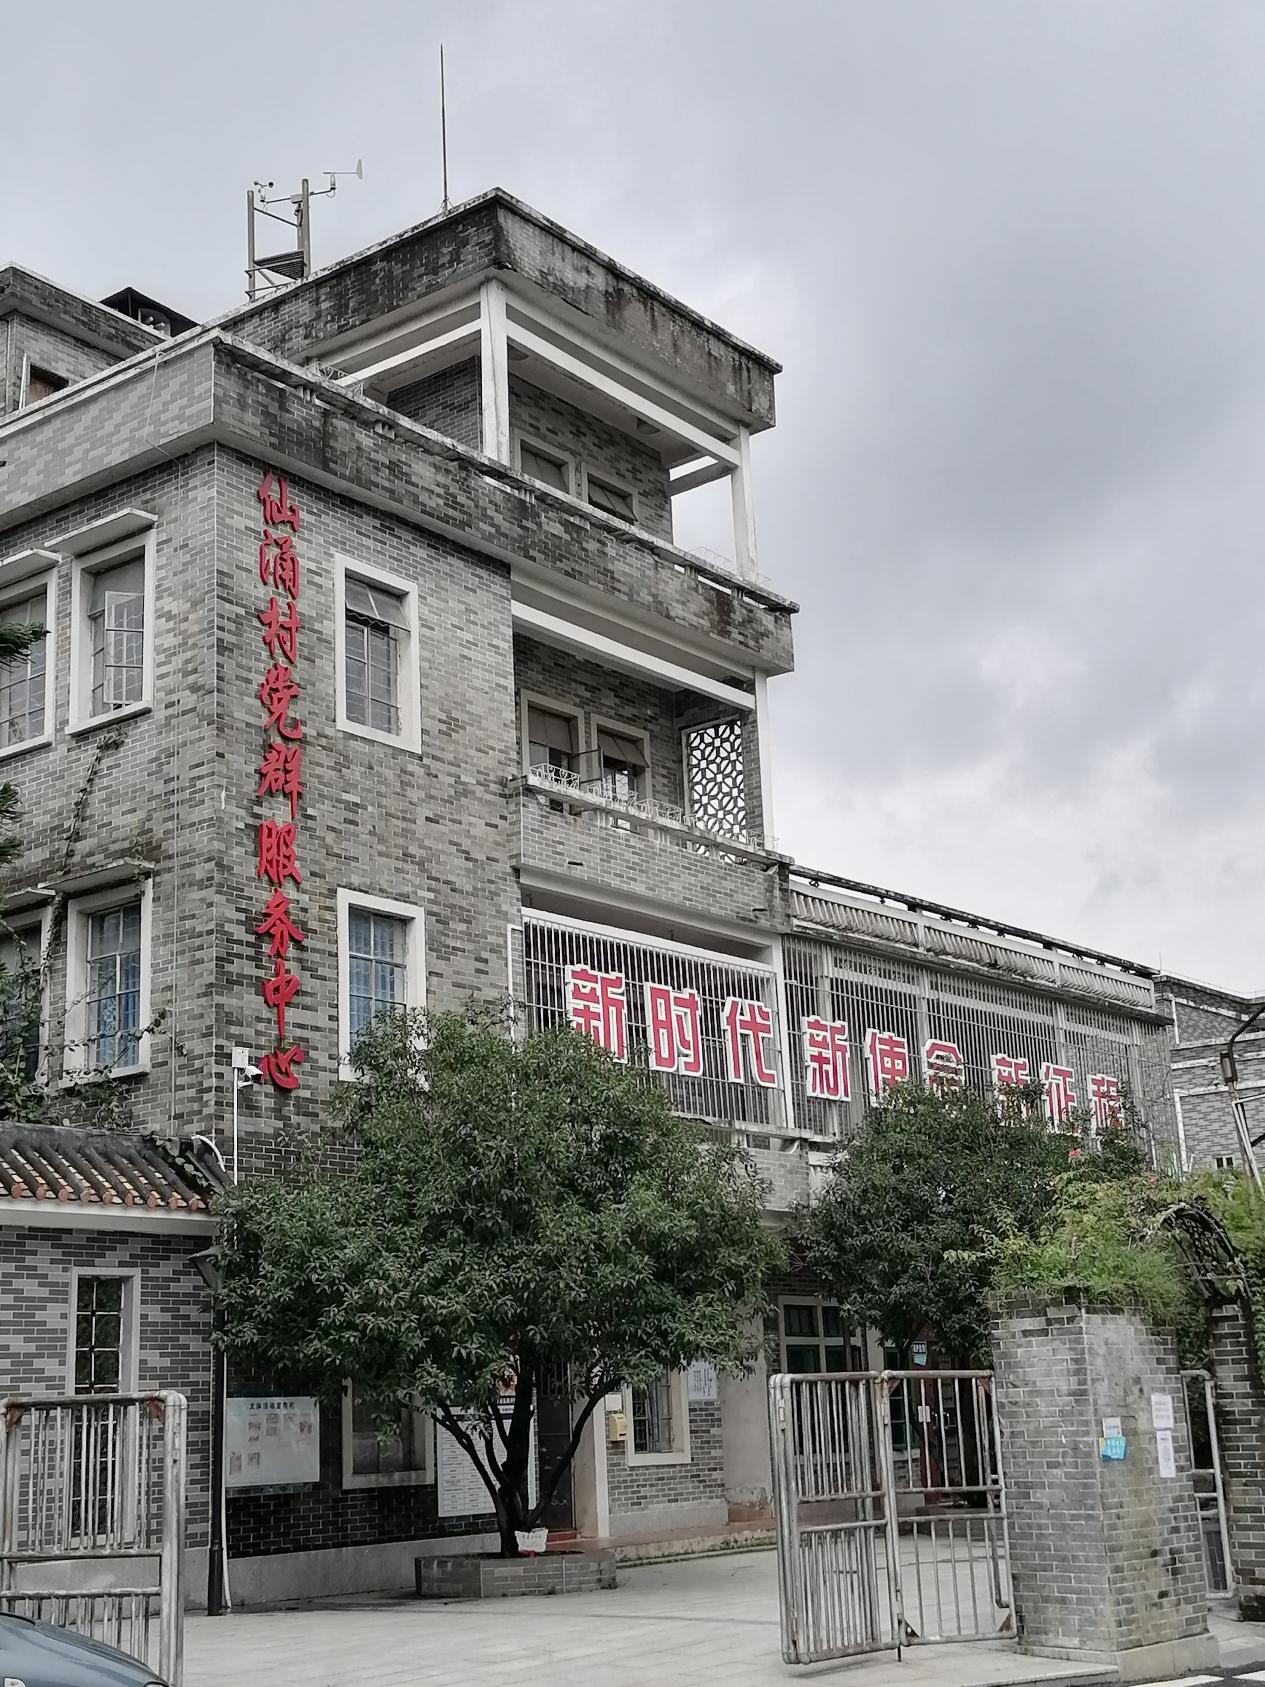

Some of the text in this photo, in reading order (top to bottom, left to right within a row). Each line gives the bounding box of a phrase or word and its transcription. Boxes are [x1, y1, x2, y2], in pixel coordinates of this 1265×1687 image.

[256, 467, 305, 1090] 仙涌村党群服务中心
[566, 964, 778, 1088] 新时代
